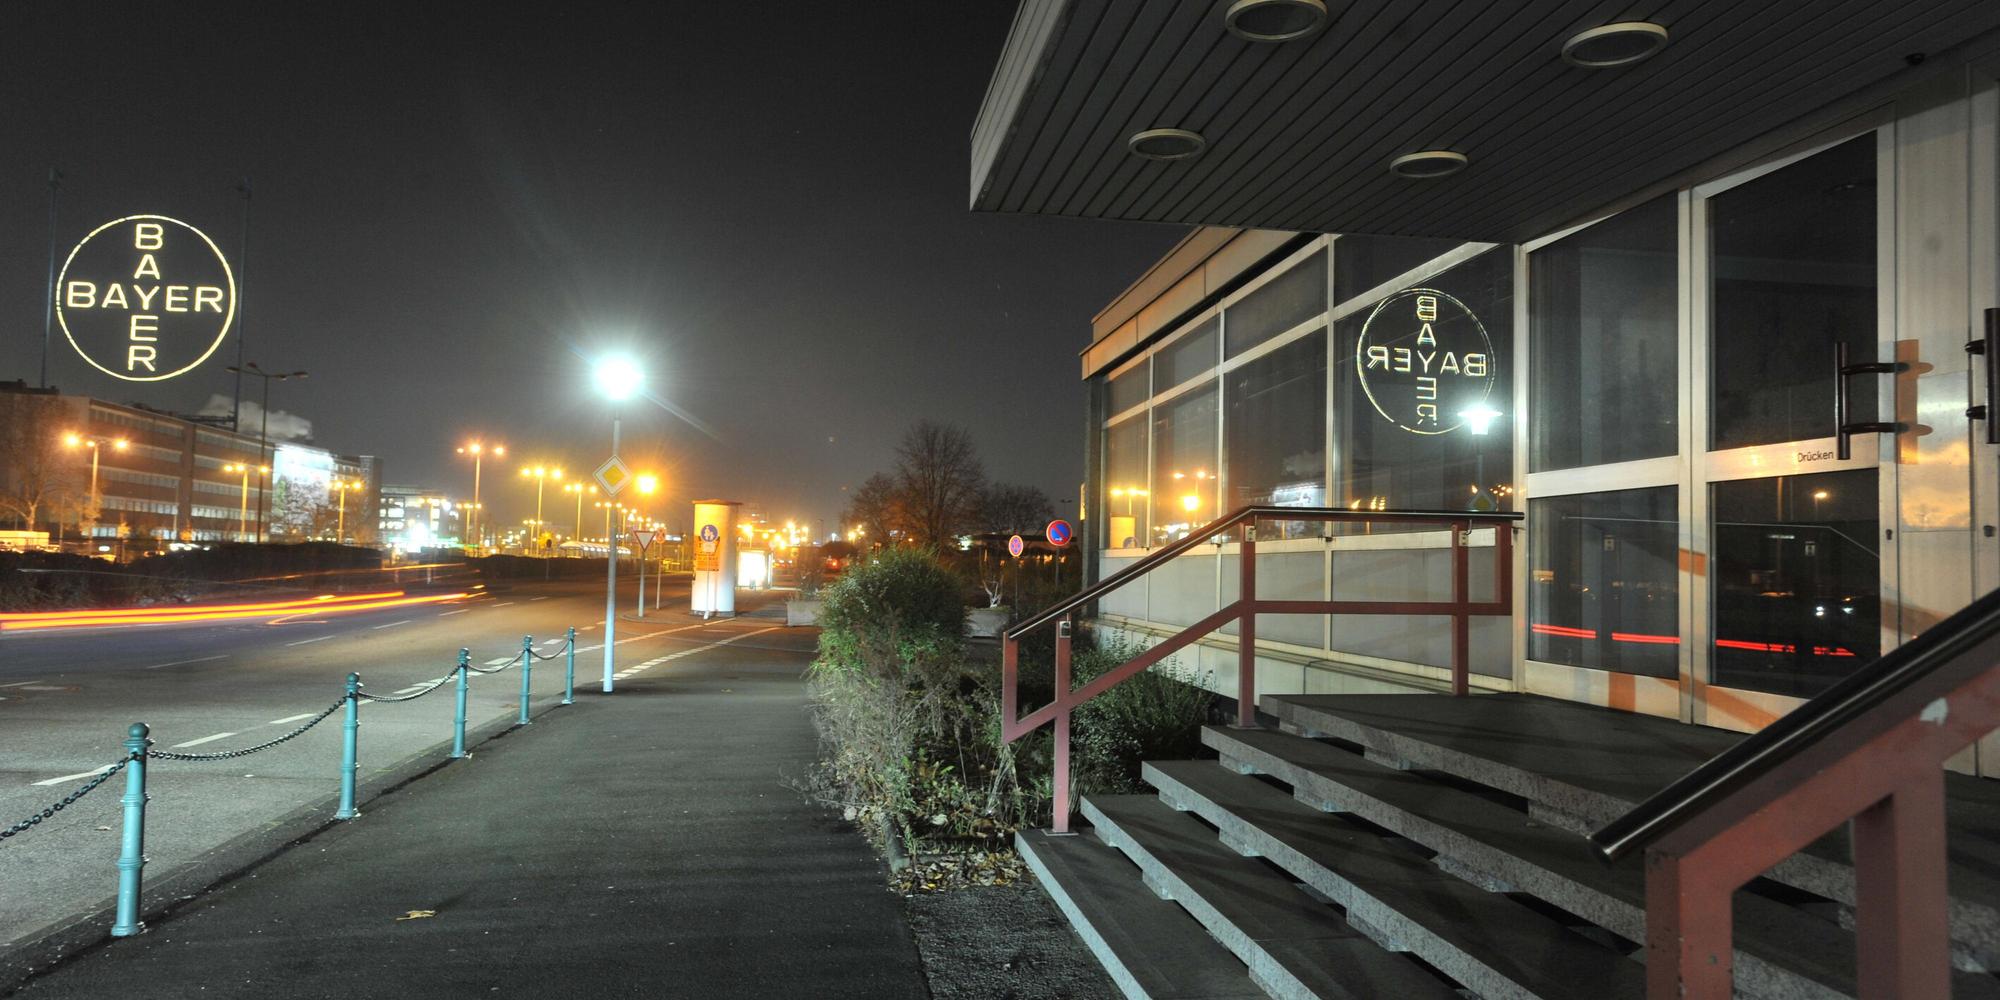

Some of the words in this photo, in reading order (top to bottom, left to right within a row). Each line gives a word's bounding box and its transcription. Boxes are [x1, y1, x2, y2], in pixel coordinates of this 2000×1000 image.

[66, 281, 224, 313] BAYER
[128, 223, 164, 372] BAYER
[1797, 450, 1834, 463] Drücken
